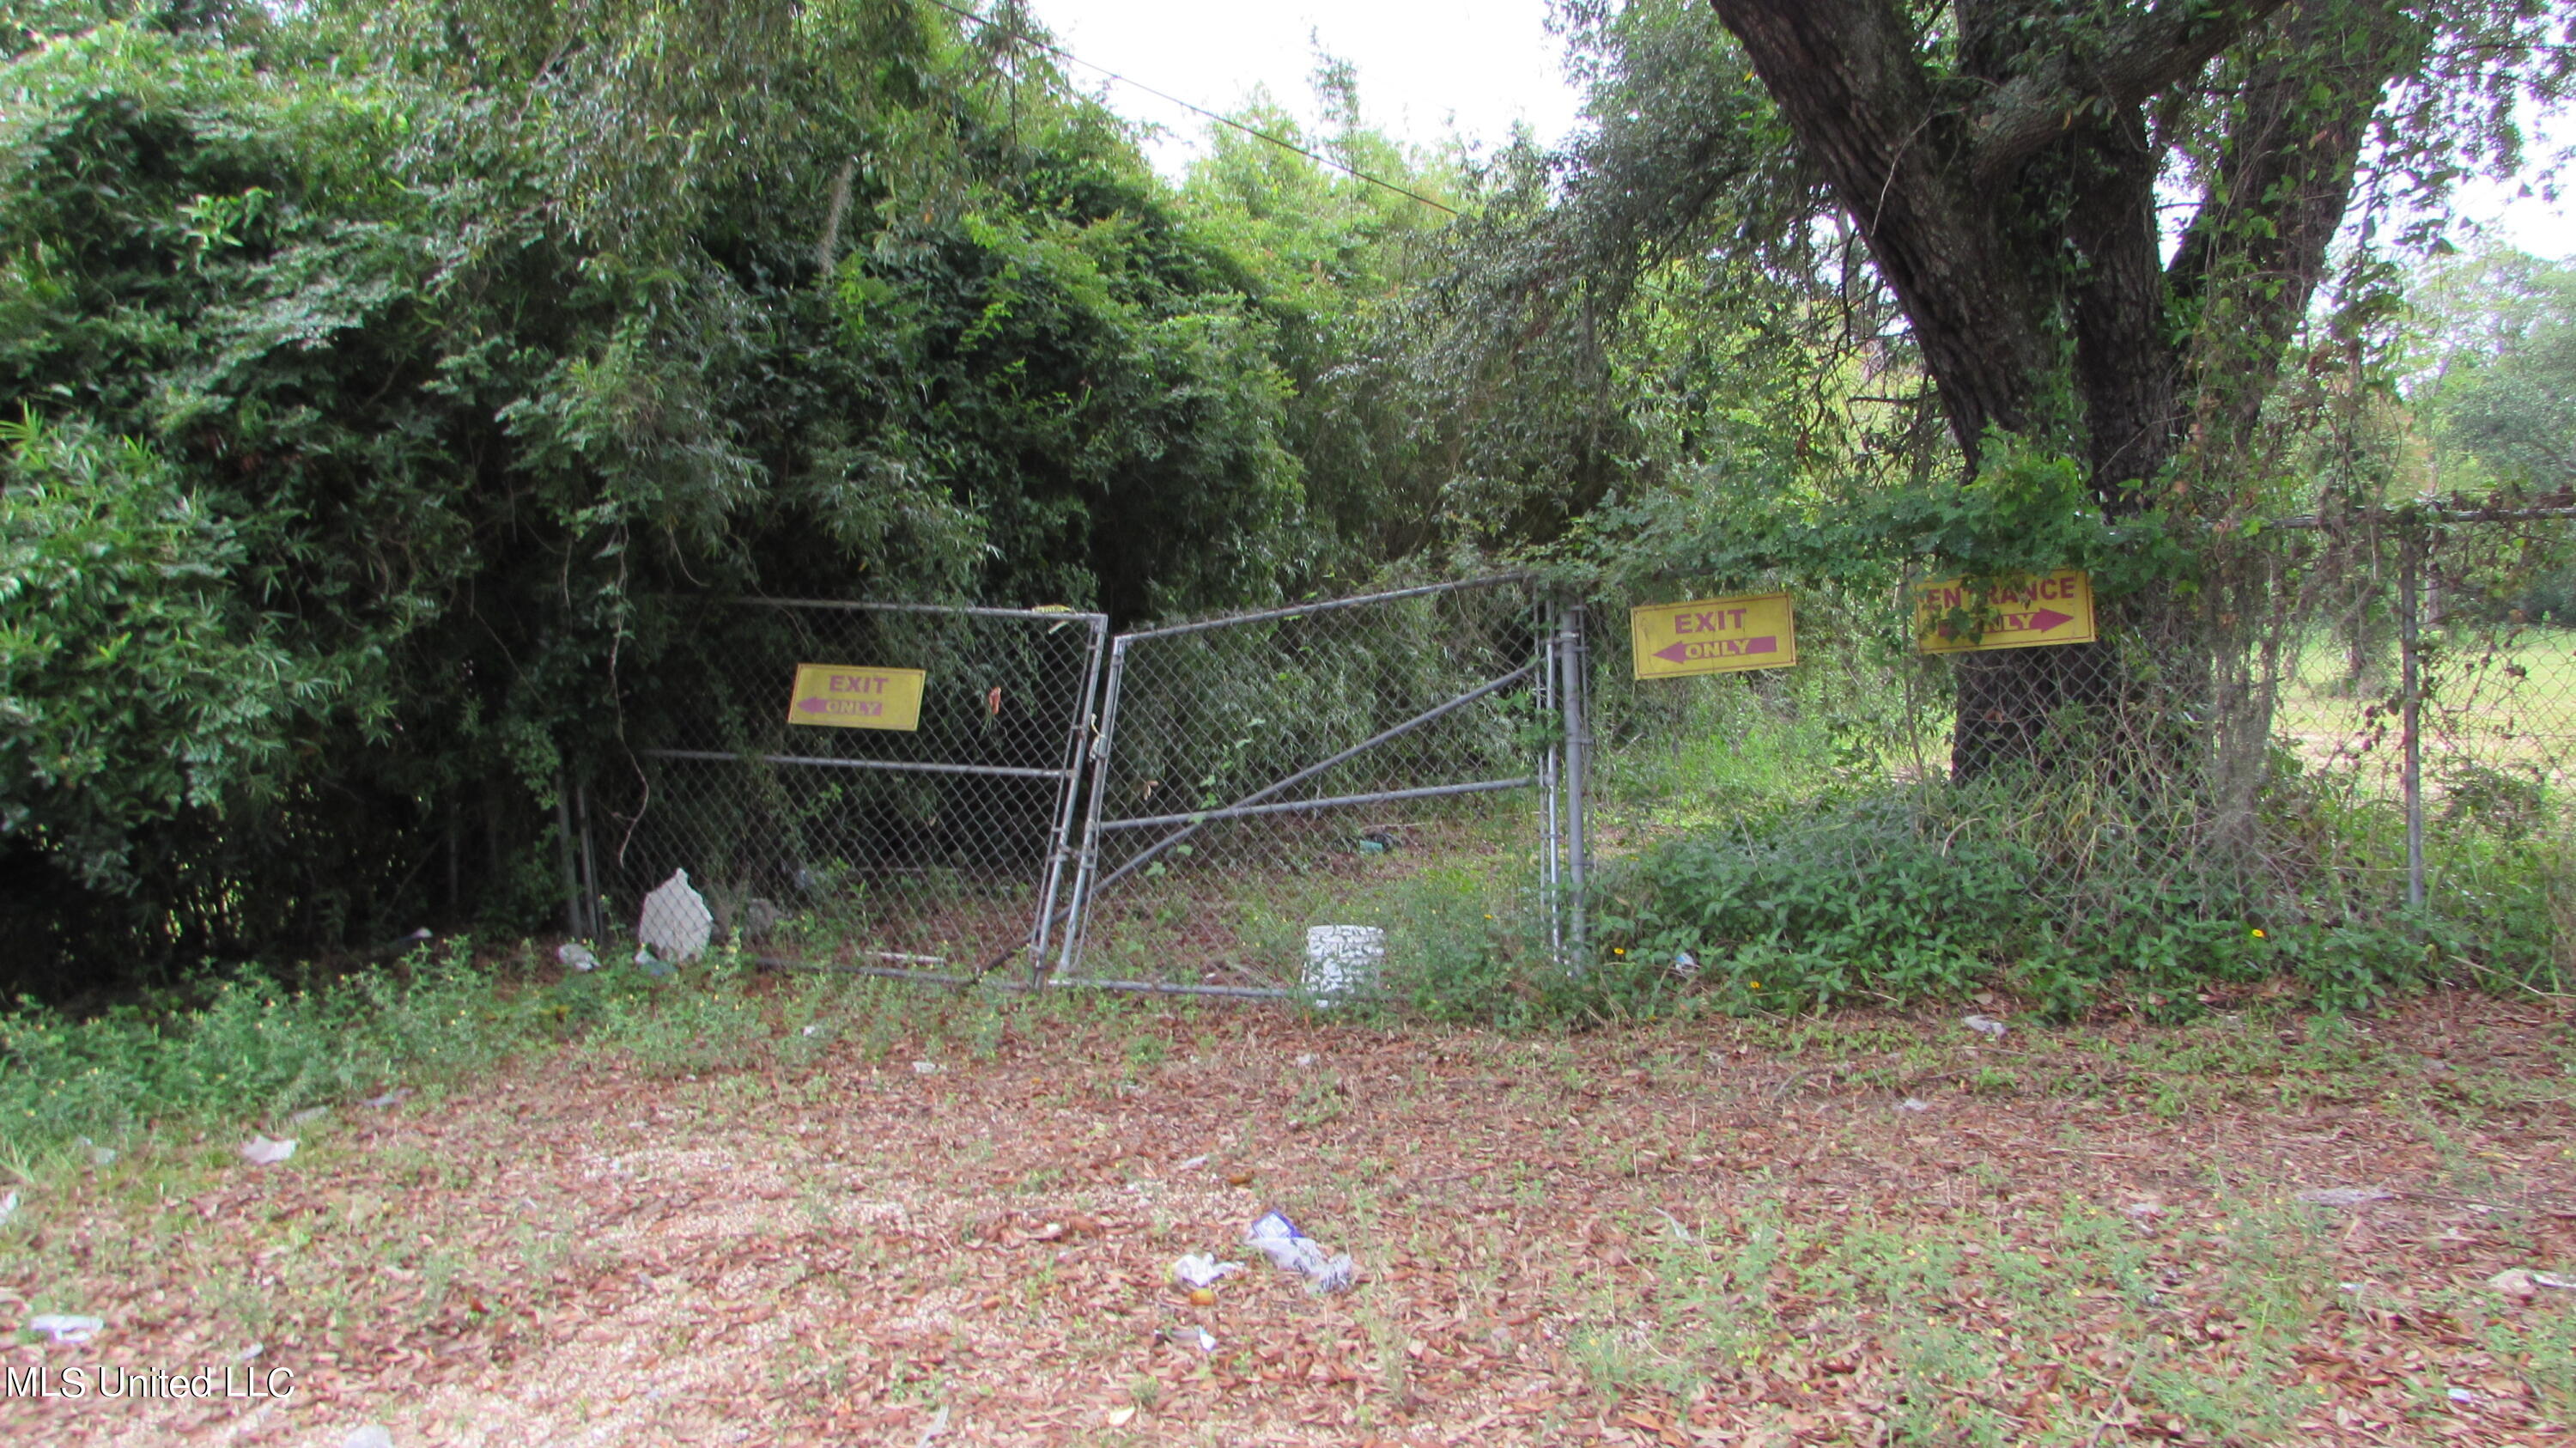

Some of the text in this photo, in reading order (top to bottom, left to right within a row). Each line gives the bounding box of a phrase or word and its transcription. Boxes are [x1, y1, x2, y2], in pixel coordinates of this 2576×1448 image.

[1926, 576, 2075, 612] ENRANCE
[1674, 608, 1747, 634] EXIT
[1967, 613, 2035, 633] NLY
[1685, 639, 1751, 660] ONLY
[829, 675, 889, 695] EXIT
[825, 700, 878, 715] ONLY
